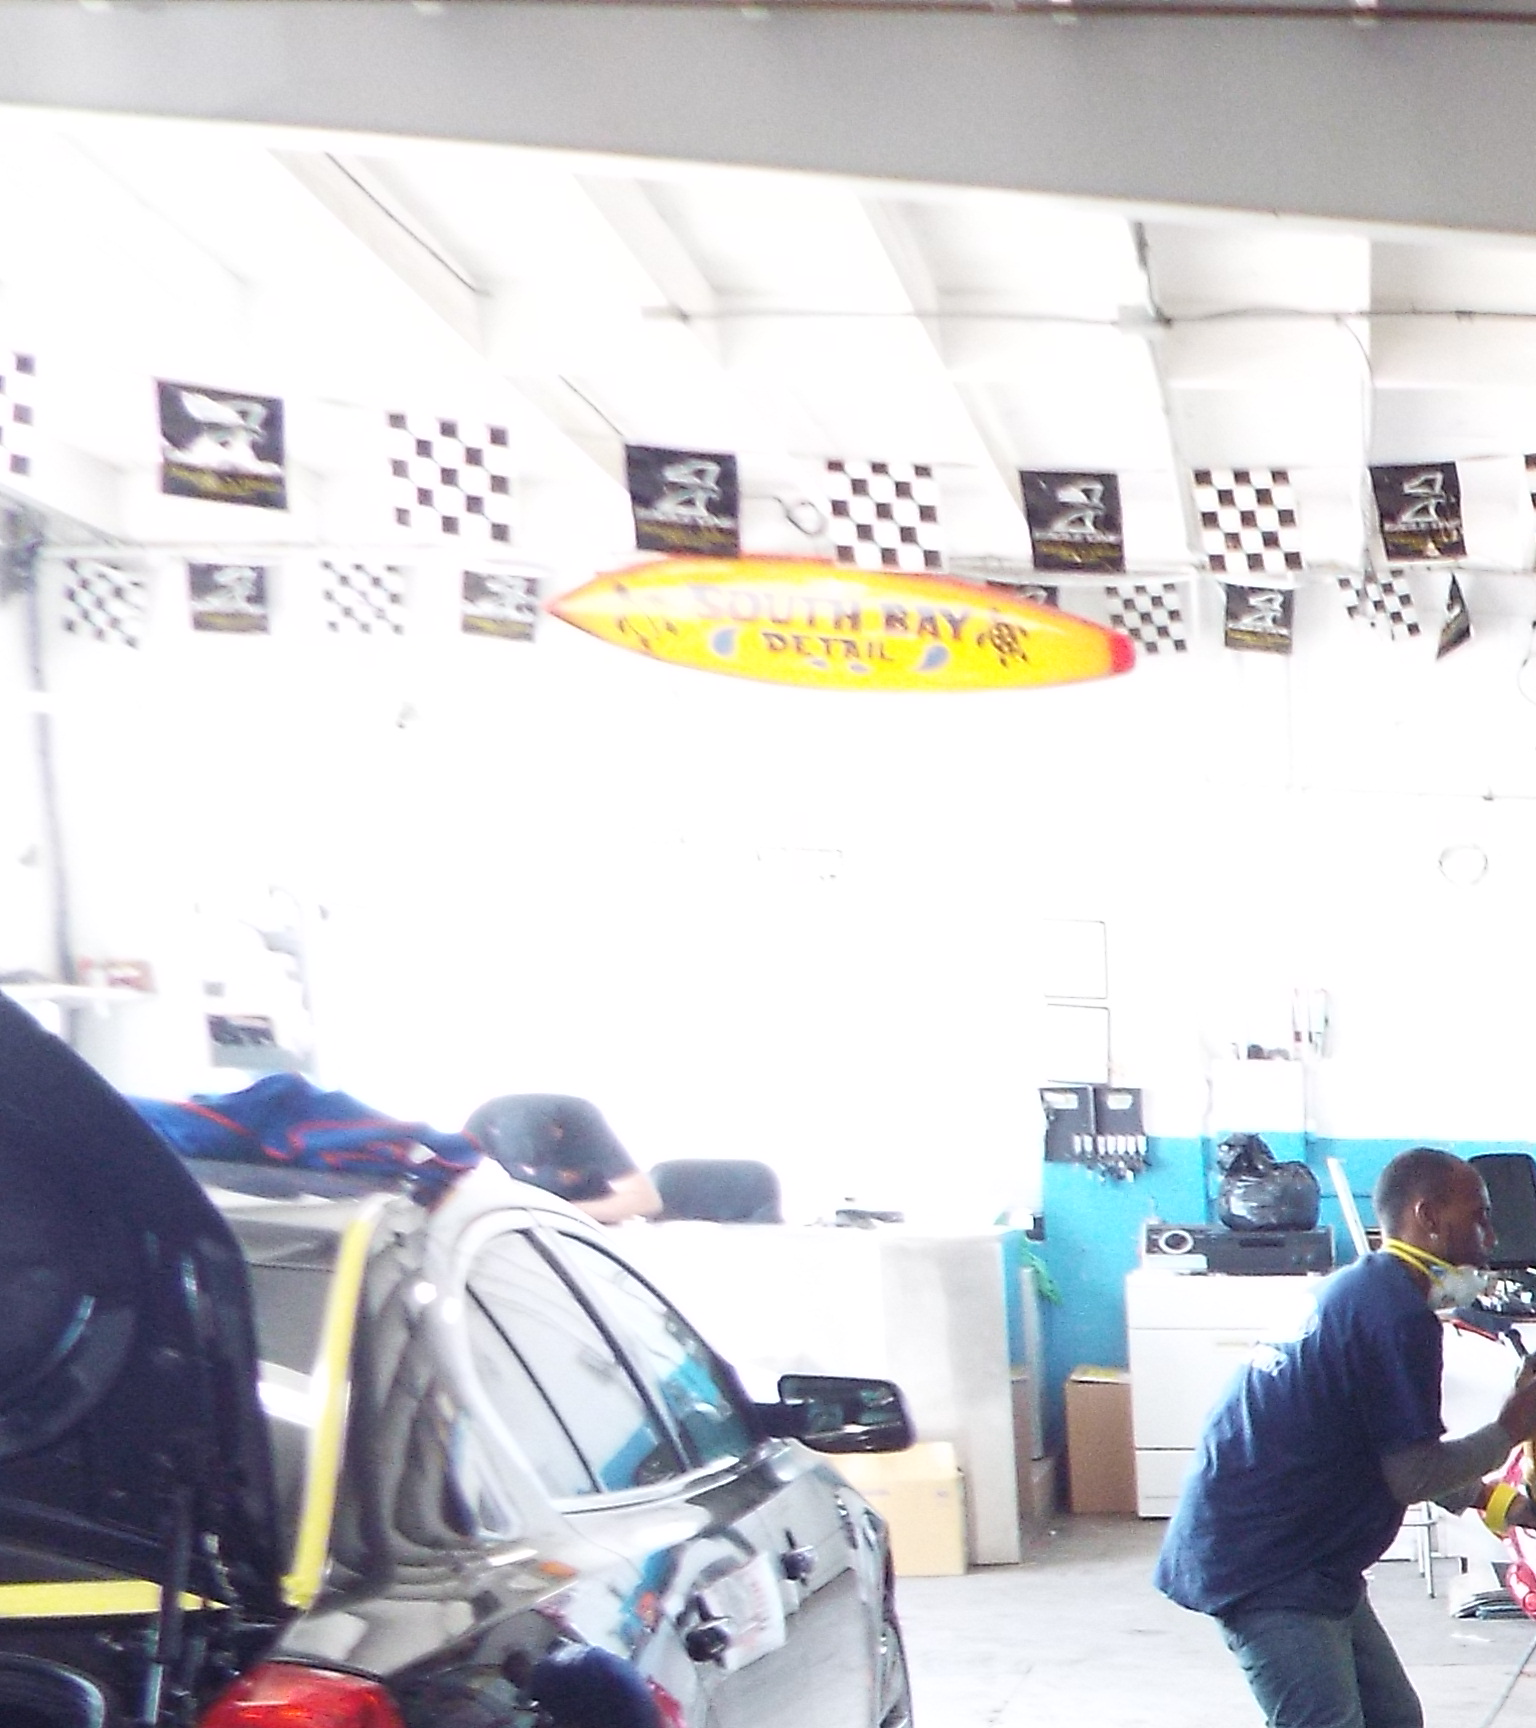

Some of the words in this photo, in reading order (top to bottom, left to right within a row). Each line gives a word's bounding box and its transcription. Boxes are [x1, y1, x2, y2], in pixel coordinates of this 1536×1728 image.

[690, 584, 861, 631] SOUTH
[883, 602, 971, 641] BAY
[762, 632, 893, 662] DETAIL
